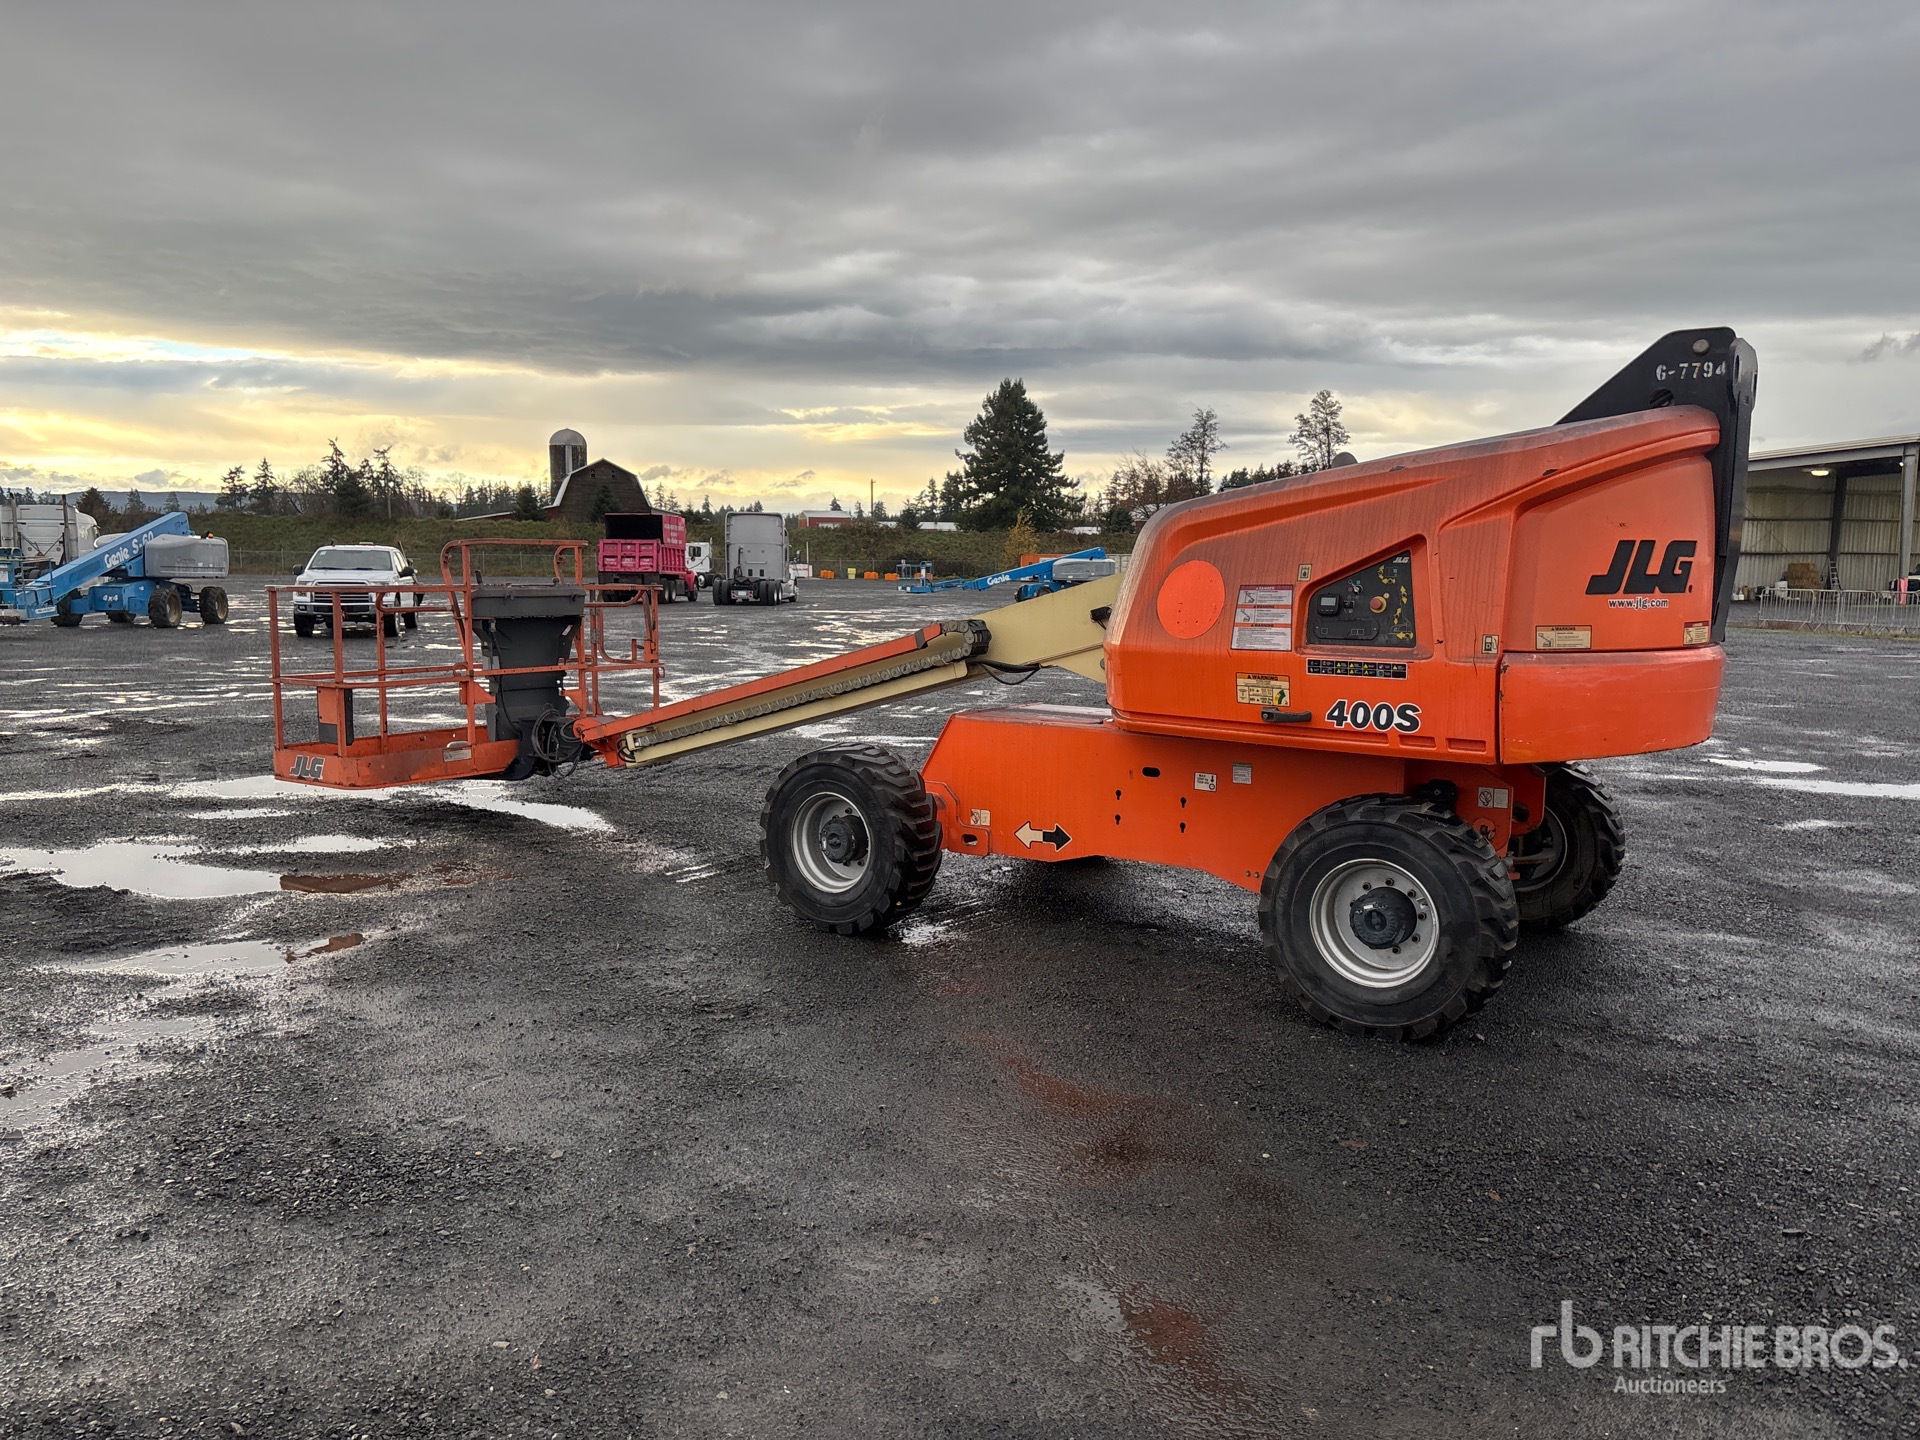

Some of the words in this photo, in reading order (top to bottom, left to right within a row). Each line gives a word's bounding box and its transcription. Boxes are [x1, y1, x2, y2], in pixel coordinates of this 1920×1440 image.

[104, 546, 130, 569] Genie
[132, 530, 154, 555] S-60
[1392, 556, 1410, 564] JLG
[986, 573, 1011, 586] Genie
[1584, 540, 1697, 594] JLG
[1608, 598, 1669, 610] www.jlg.com
[1325, 699, 1422, 734] 400S
[289, 755, 325, 780] JLG
